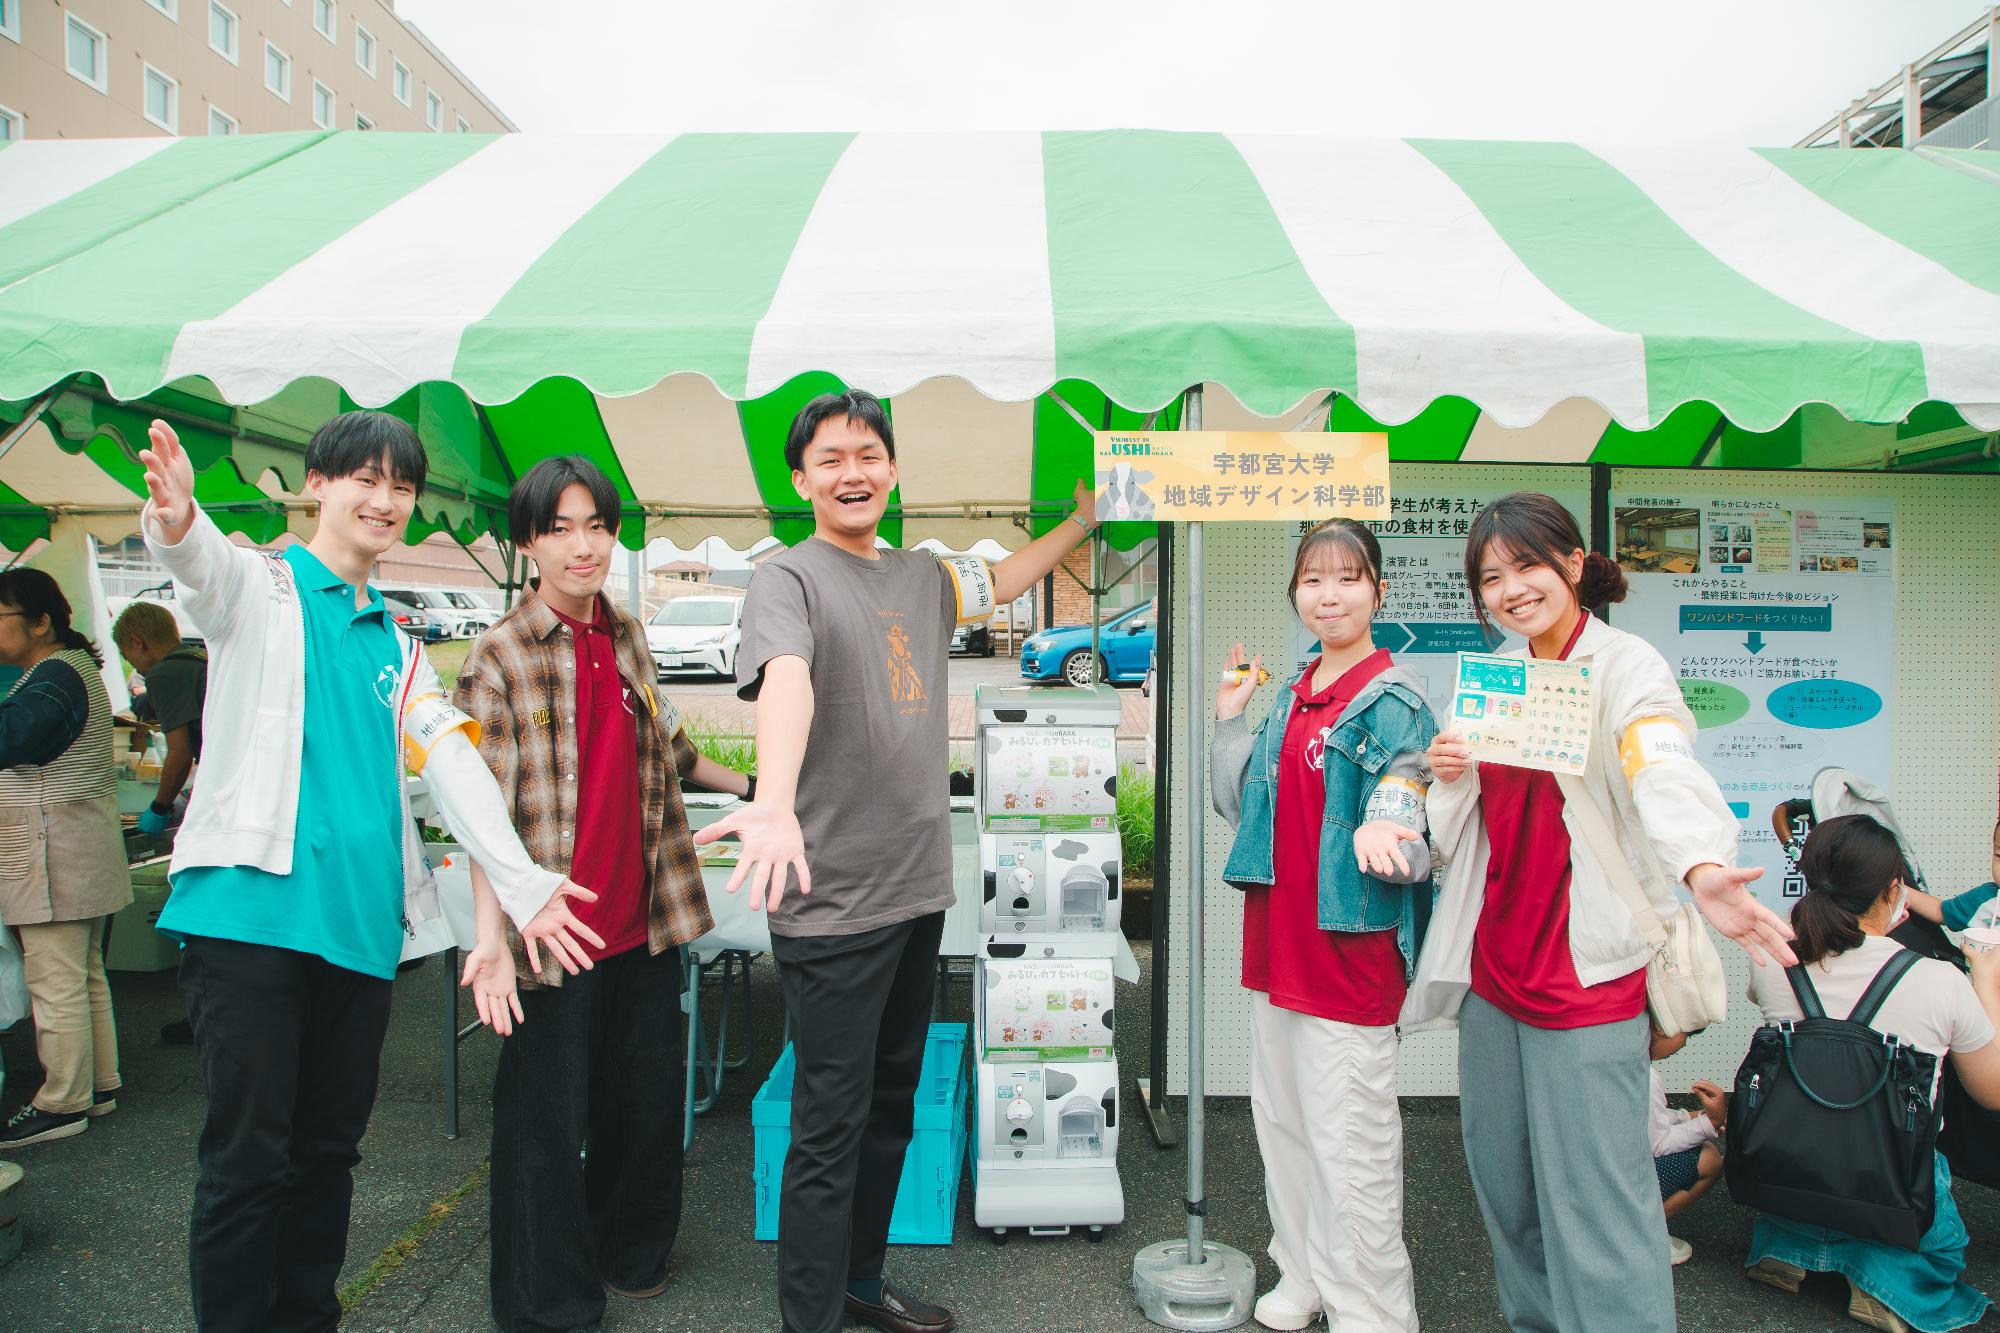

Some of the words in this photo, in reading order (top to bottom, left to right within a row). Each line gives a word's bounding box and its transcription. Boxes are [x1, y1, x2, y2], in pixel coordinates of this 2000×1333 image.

[1111, 443, 1151, 456] USHI
[1212, 452, 1335, 475] 宇都宮大学
[1163, 484, 1385, 508] 地域デザイン科学部
[1711, 500, 1781, 510] 明らかになったこと
[1672, 578, 1747, 588] これからやること
[1687, 612, 1825, 624] ワンハンドフードをつくりたい！
[1680, 656, 1838, 668] どんなワンハンドフードが食べたいか
[1680, 668, 1838, 680] 教えてください！ご協力お願いします
